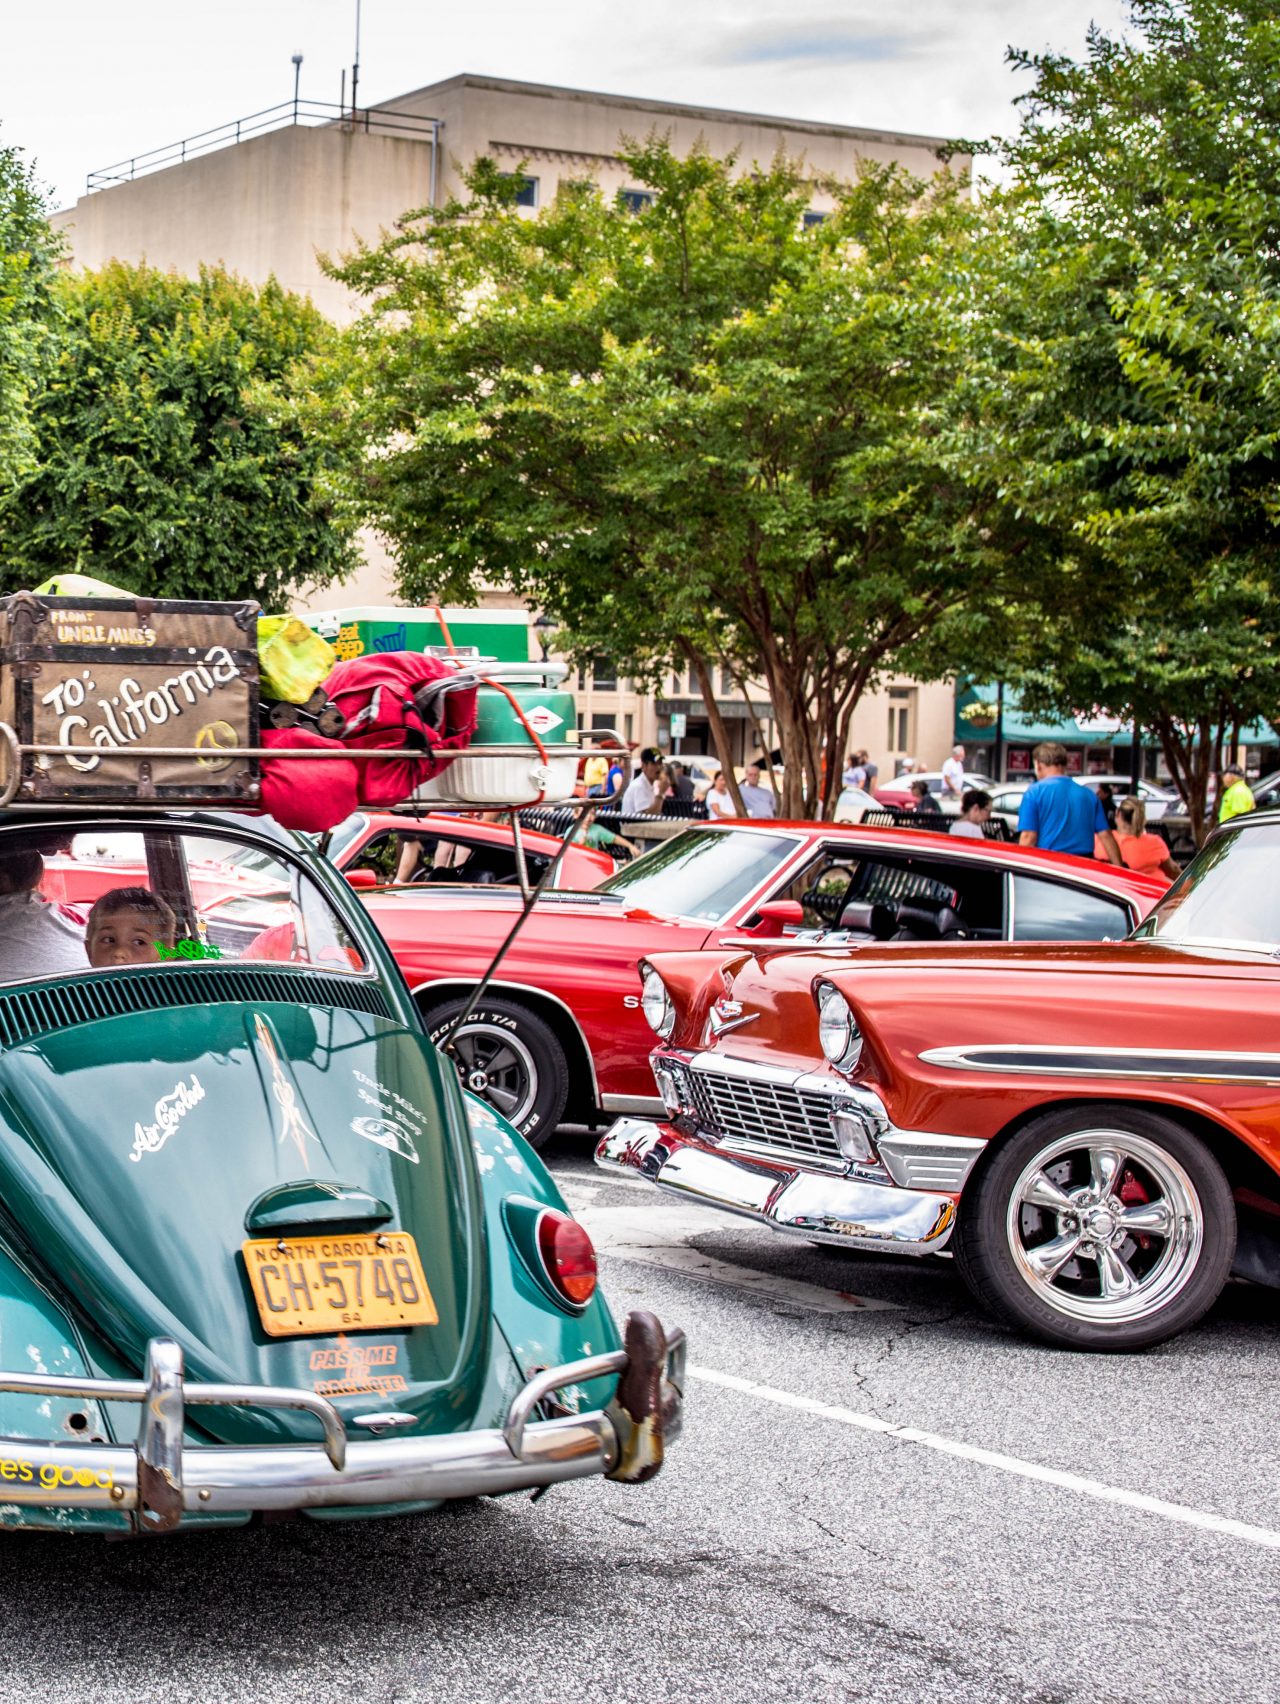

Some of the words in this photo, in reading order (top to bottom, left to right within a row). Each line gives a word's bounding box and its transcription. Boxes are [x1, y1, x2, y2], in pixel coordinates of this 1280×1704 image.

[57, 625, 107, 643] UNCLE
[340, 623, 359, 641] eat
[59, 645, 240, 772] California
[623, 995, 644, 1008] S
[430, 1012, 486, 1043] Radal
[491, 1014, 518, 1030] T/A
[255, 1243, 316, 1262] NORTH
[342, 1313, 362, 1324] 64
[313, 1348, 363, 1367] PASS
[368, 1346, 395, 1365] ME
[39, 1464, 114, 1490] good
